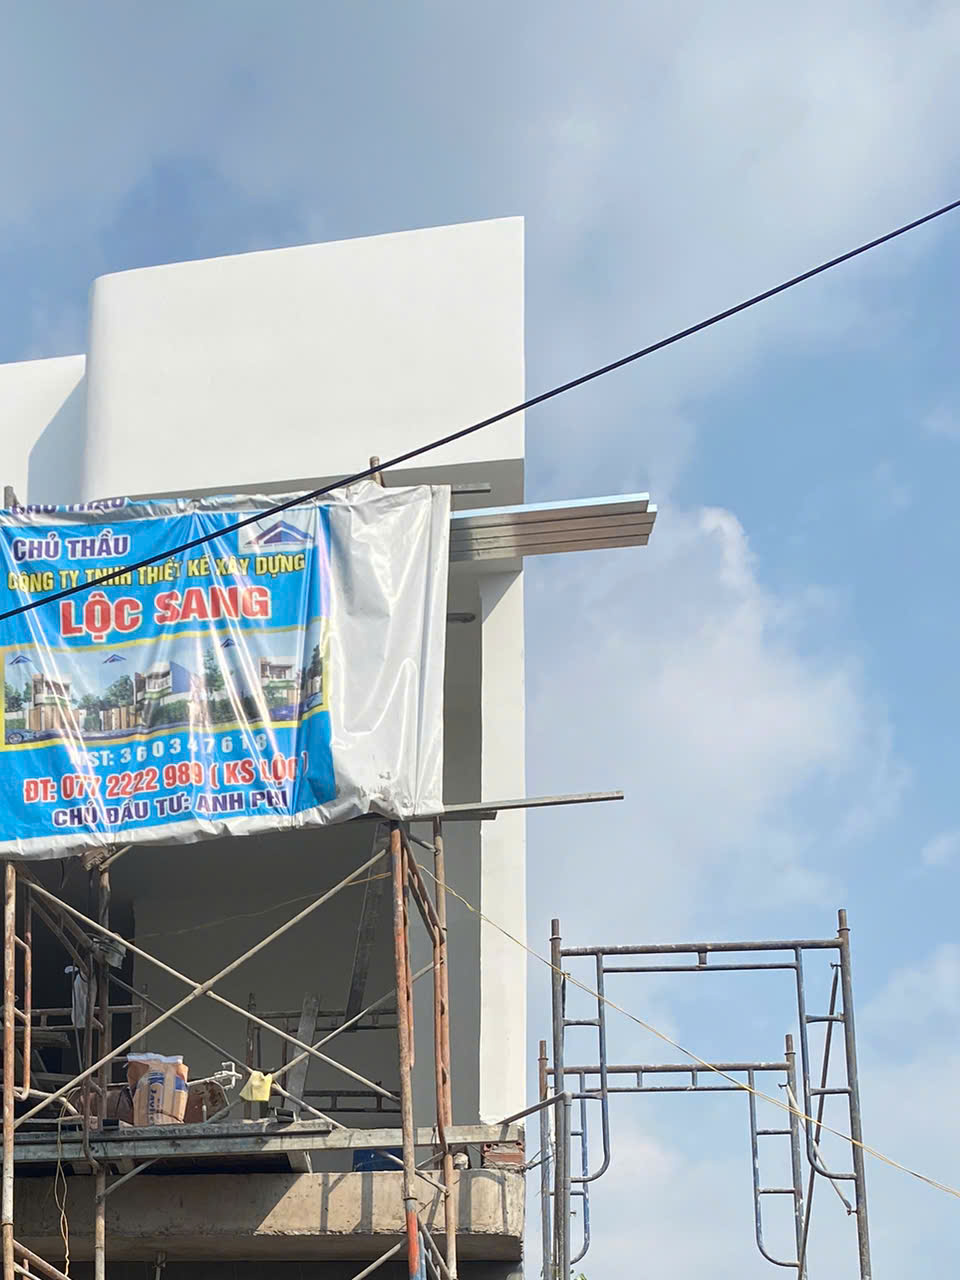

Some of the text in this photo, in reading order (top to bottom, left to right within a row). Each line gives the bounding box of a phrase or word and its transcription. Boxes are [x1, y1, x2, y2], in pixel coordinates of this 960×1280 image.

[12, 528, 131, 563] CHỦ THẦU
[8, 569, 54, 593] CÔNG
[59, 569, 80, 589] TY
[255, 552, 306, 579] DỰNG
[59, 585, 272, 642] LỘC SANG
[24, 776, 57, 804] ĐT:
[61, 772, 101, 800] 077
[106, 766, 160, 799] 2222
[163, 760, 204, 789] 989
[224, 758, 255, 785] KS
[53, 800, 99, 827] CHỦ
[155, 791, 191, 818] TƯ:
[196, 791, 244, 814] ANH
